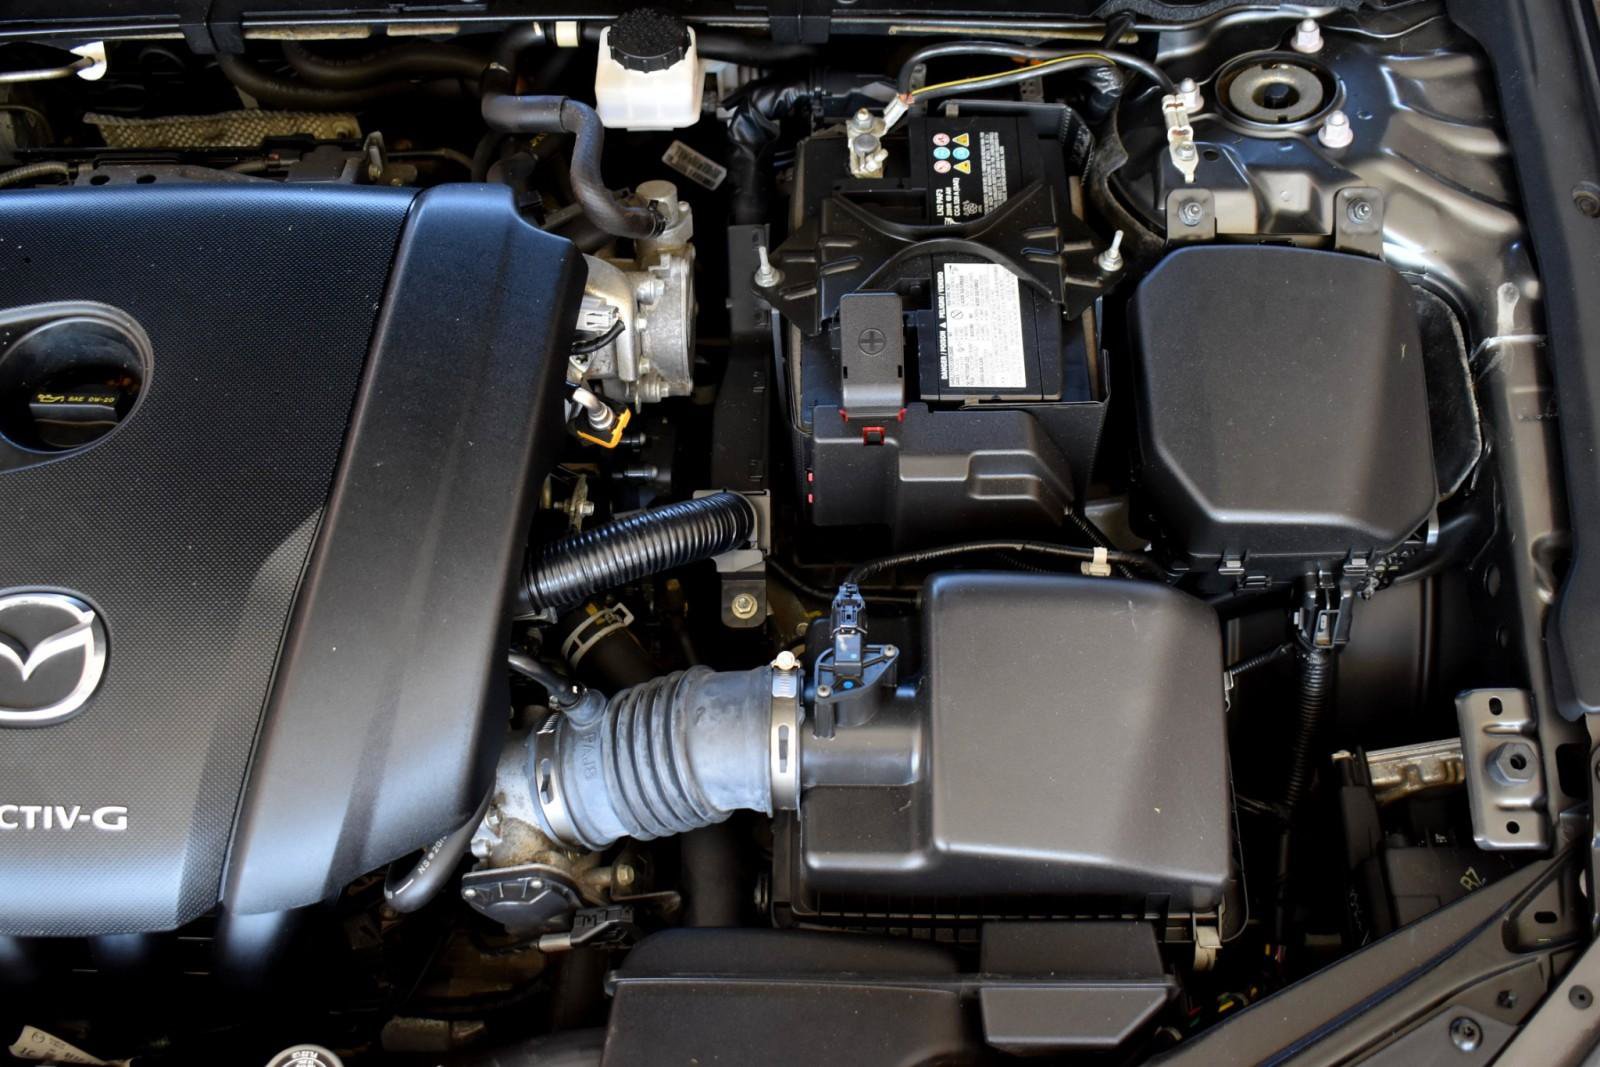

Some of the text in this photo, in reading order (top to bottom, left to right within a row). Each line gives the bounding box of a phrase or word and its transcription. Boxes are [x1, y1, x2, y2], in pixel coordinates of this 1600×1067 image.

[938, 296, 946, 319] PELIGRO
[939, 330, 947, 352] POISON
[940, 355, 948, 380] DANGER
